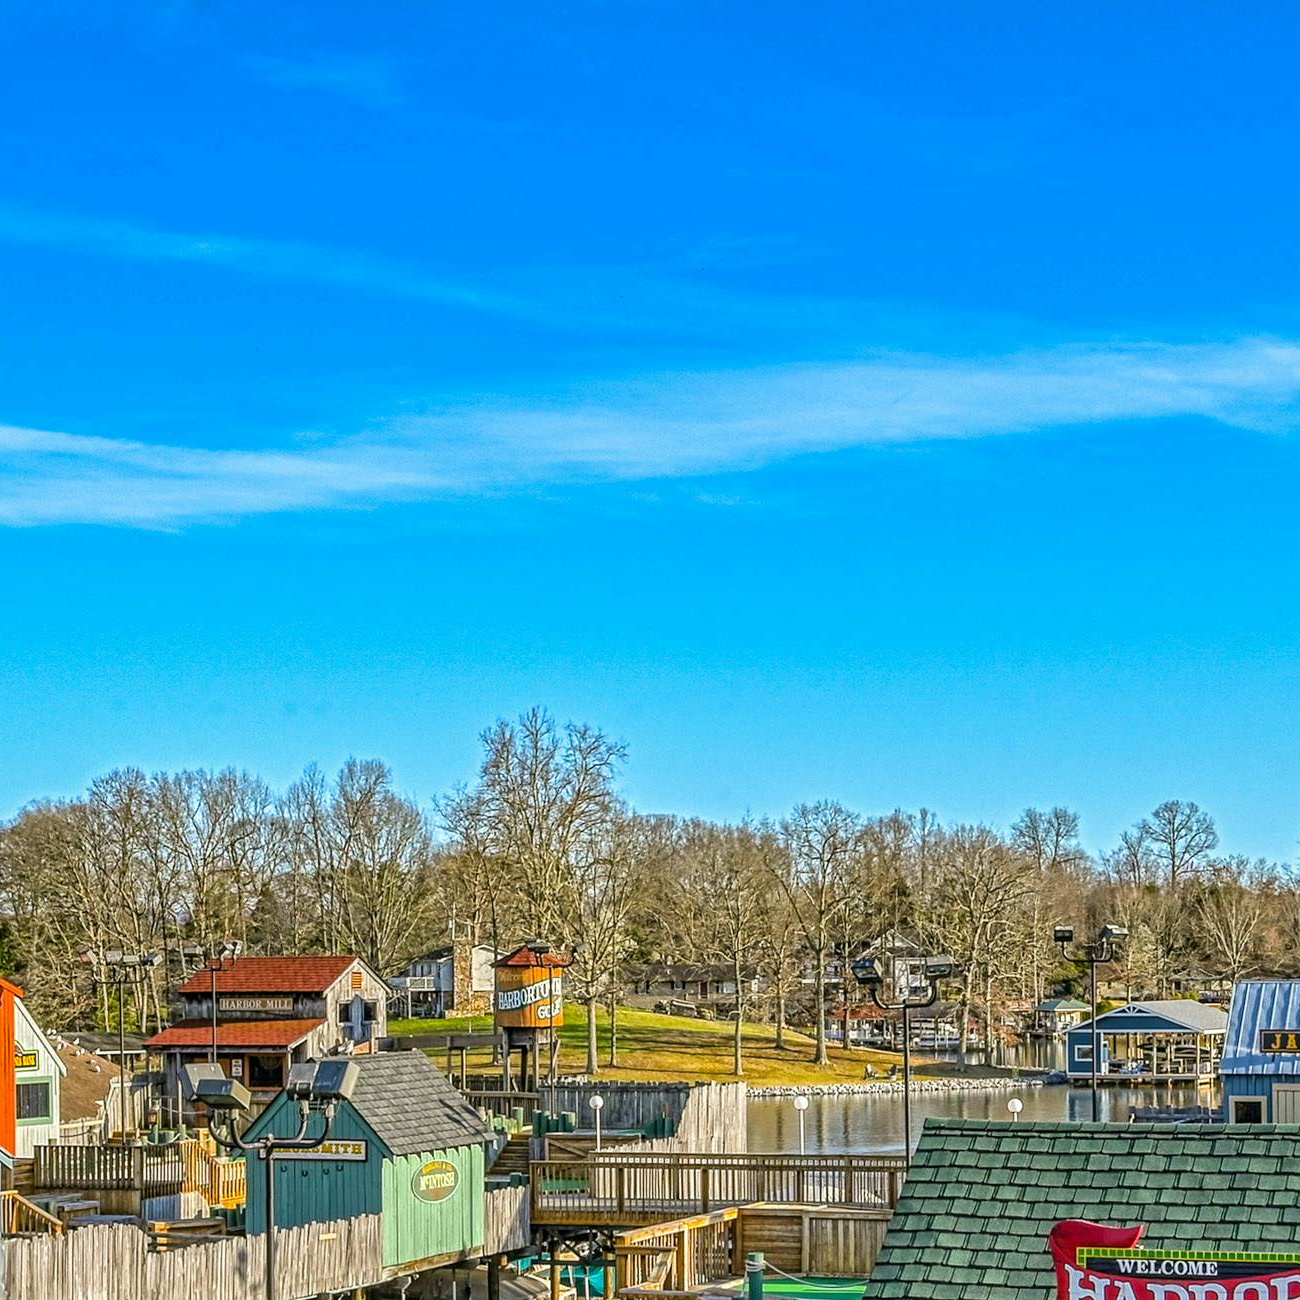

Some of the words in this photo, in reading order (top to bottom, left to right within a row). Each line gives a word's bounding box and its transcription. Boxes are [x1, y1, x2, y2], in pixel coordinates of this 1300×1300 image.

[222, 999, 262, 1009] HARBOR
[266, 999, 291, 1009] MILL
[1116, 1259, 1218, 1276] WELCOME
